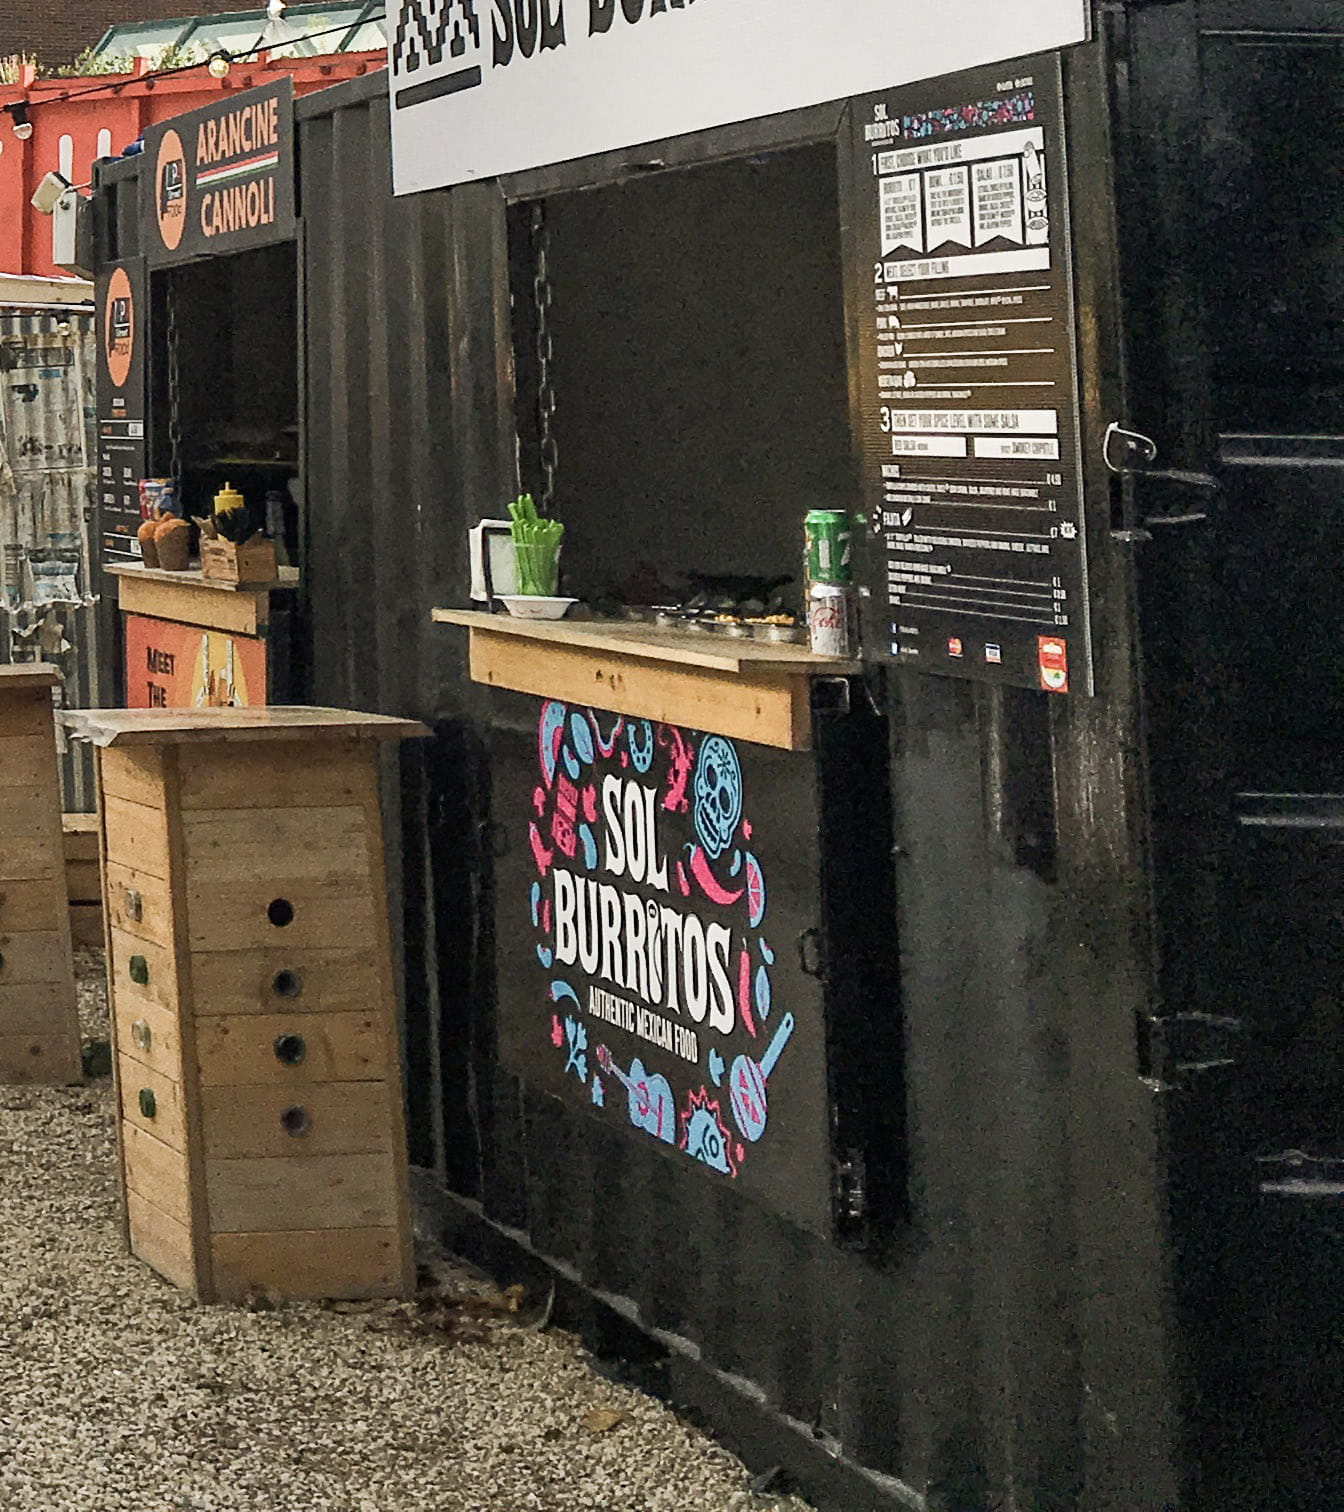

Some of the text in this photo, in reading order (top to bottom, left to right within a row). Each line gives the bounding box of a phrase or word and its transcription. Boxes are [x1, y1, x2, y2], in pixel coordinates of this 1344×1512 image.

[874, 104, 889, 121] SOL
[197, 97, 278, 166] ARANCINE
[865, 119, 900, 141] BURRITOS
[871, 154, 878, 176] 1
[201, 177, 274, 237] CANNOLI
[874, 262, 884, 283] 2
[880, 406, 891, 433] 3
[146, 646, 176, 676] MEET
[147, 681, 168, 708] THE
[602, 774, 669, 892] SOL
[553, 868, 735, 1035] BURRITOS
[589, 986, 699, 1065] AUTHENTIC MEXICAN FOOD
